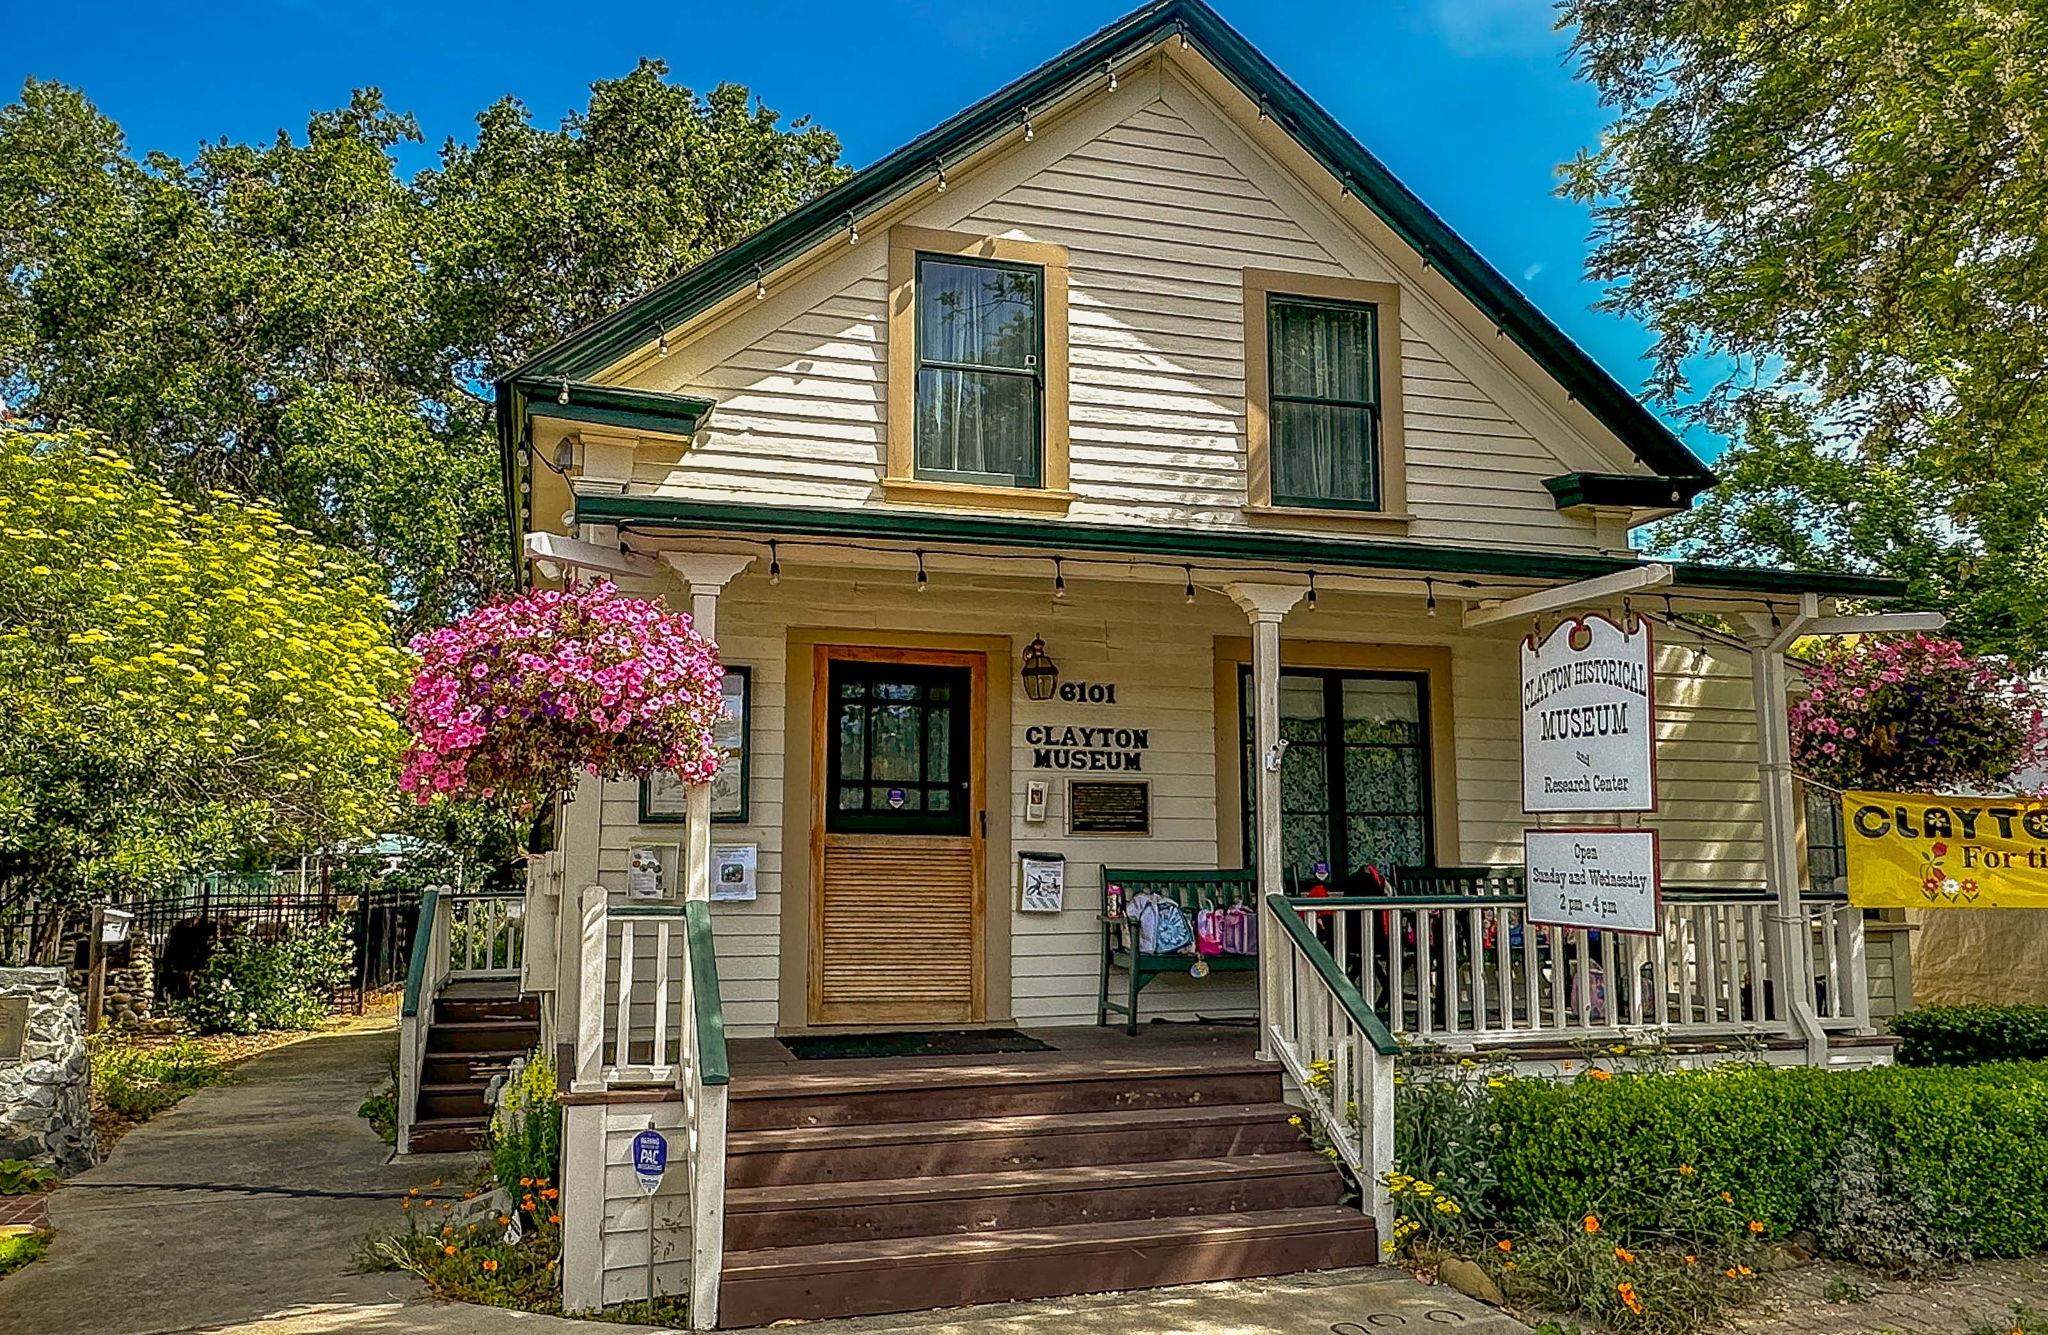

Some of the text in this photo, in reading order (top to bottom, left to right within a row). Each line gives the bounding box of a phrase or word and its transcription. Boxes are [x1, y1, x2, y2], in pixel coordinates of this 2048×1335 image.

[1060, 682, 1116, 704] 6101
[1524, 659, 1647, 711] CLAYTON HISTORICAL
[1540, 702, 1628, 741] MUSEUM
[1026, 726, 1149, 749] CLAYTON
[1033, 748, 1142, 771] MUSEUM
[1544, 774, 1629, 793] Research Center
[1574, 843, 1598, 864] Open
[1962, 846, 2017, 869] For
[1533, 867, 1648, 894] Sunday and Wednesday
[1560, 893, 1566, 910] 2
[1568, 899, 1583, 915] pm
[1592, 895, 1600, 912] 4
[1601, 900, 1617, 918] pm
[641, 1149, 660, 1165] PAC
